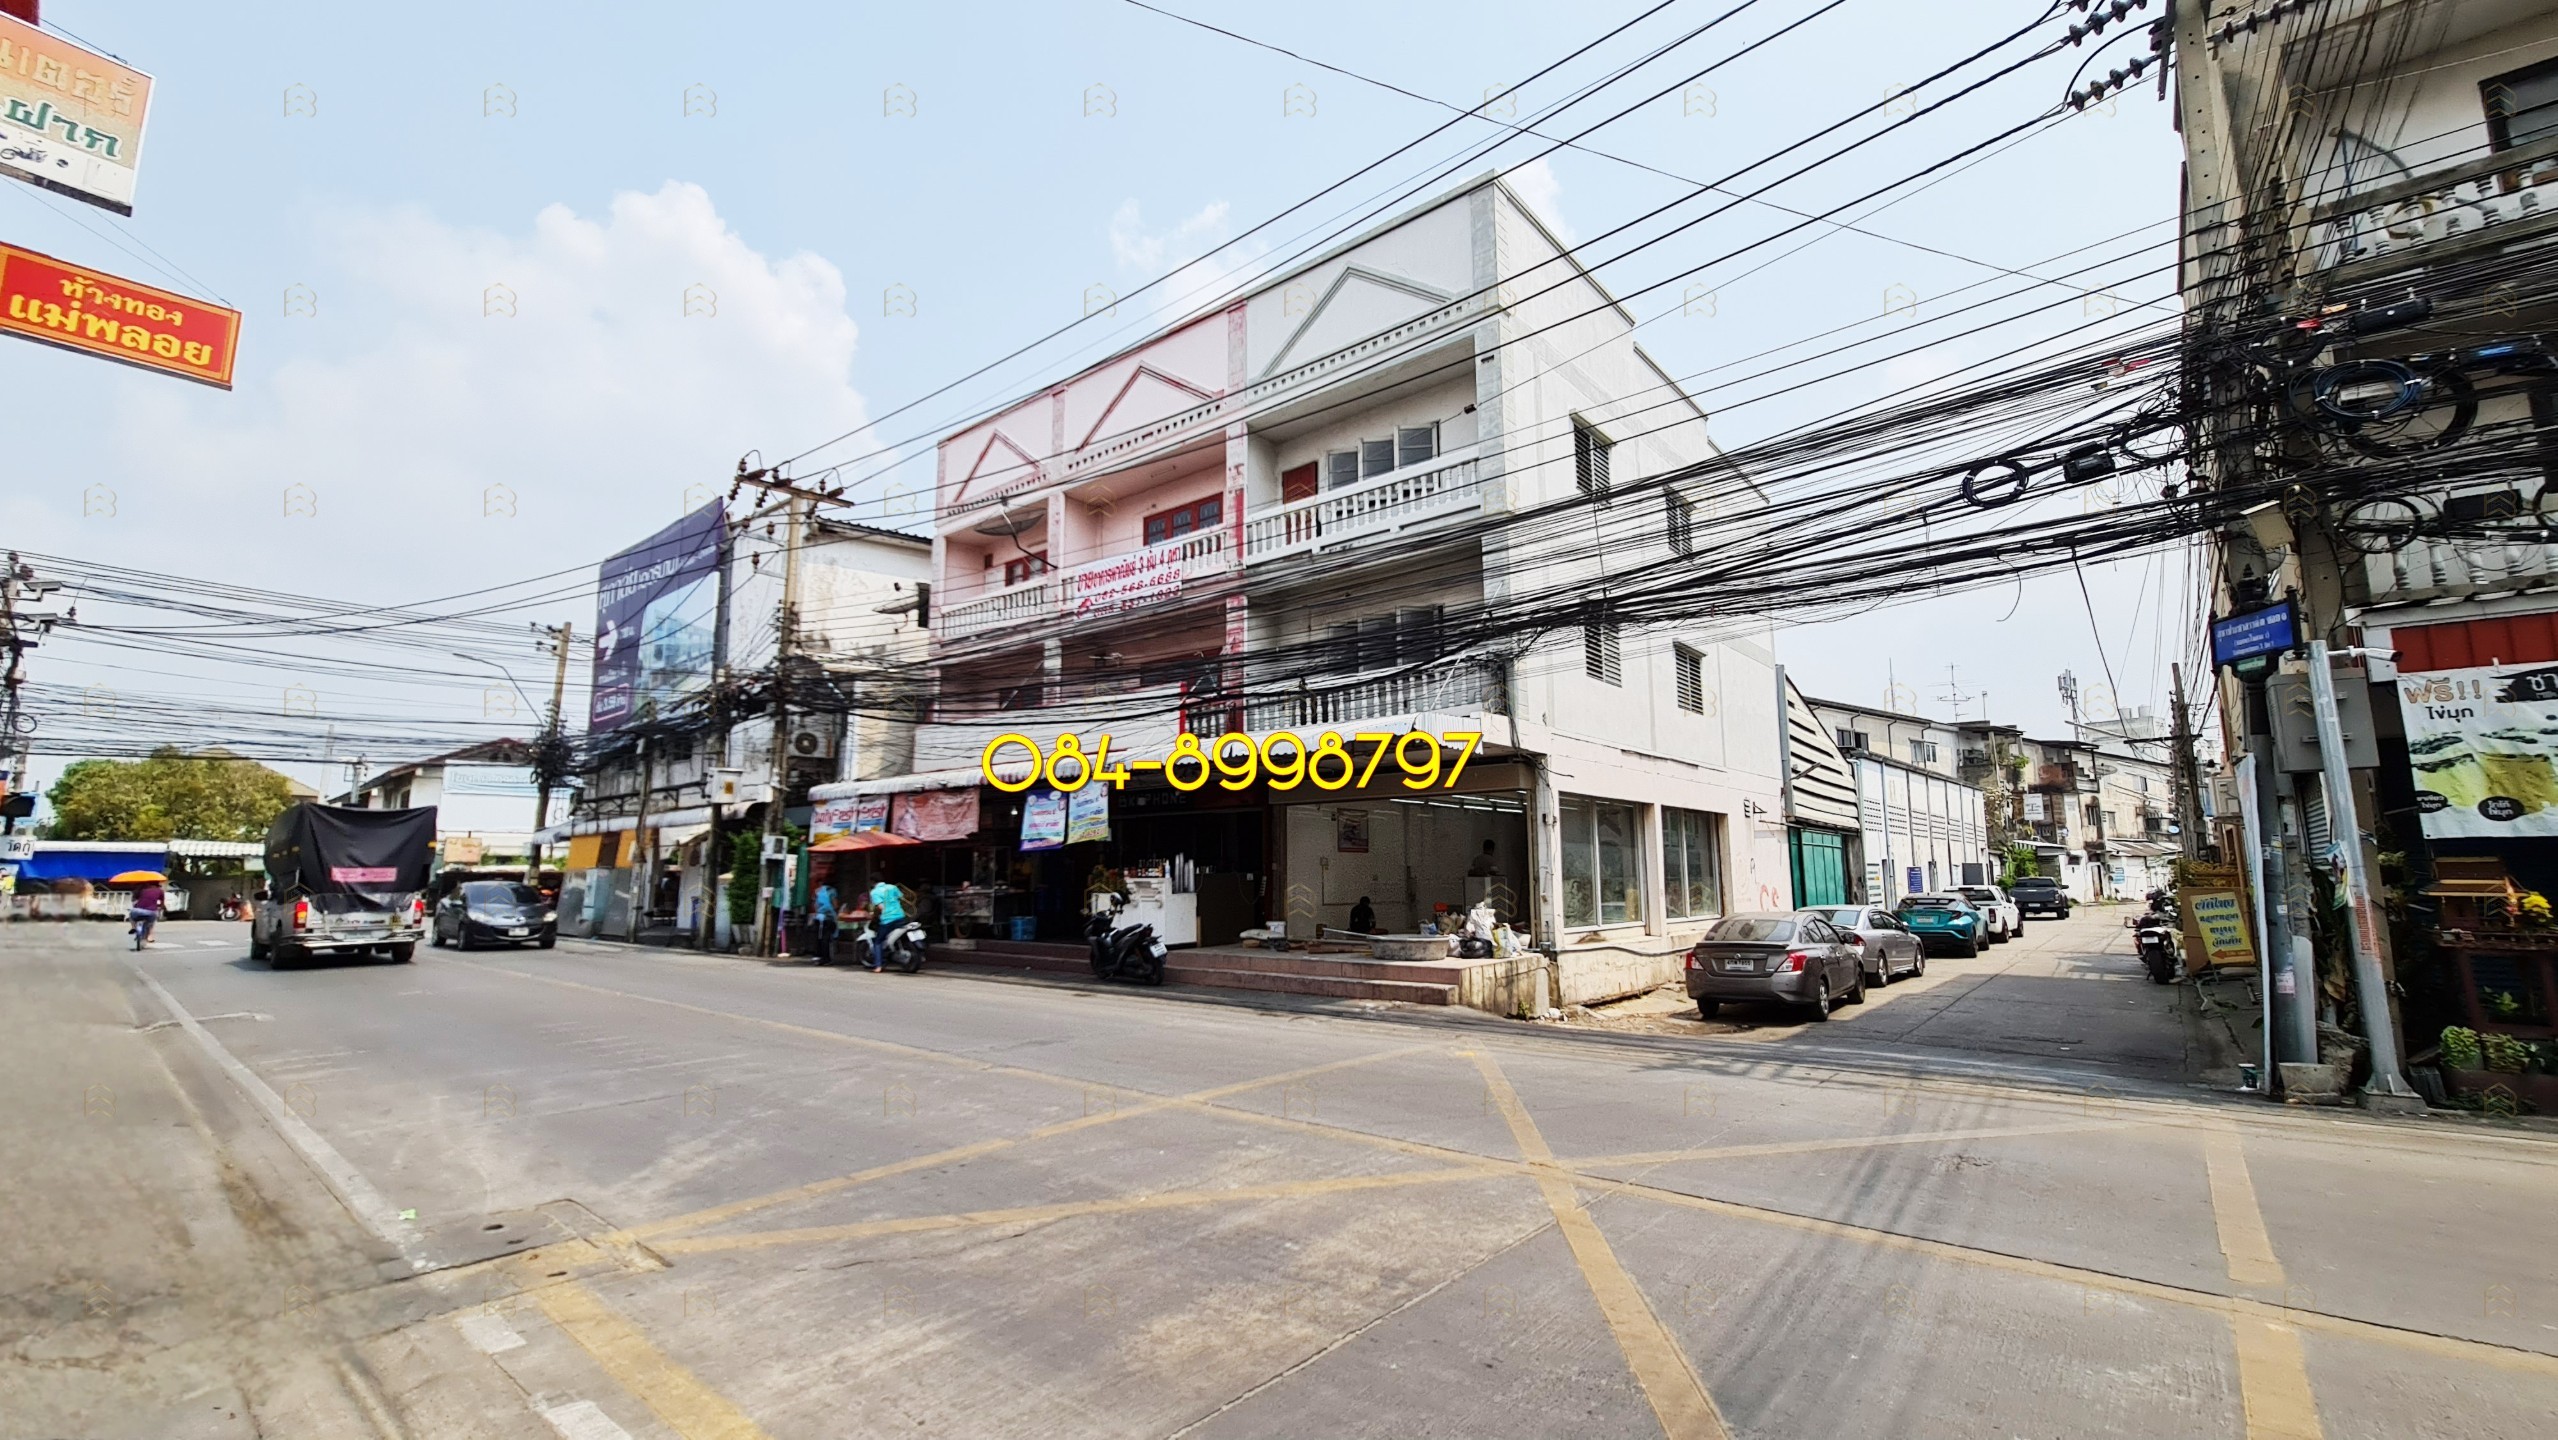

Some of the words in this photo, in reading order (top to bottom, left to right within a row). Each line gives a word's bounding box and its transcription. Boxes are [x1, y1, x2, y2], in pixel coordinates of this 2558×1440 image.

[59, 276, 184, 326] ห้างทอง
[9, 294, 213, 366] แม่พลอย
[2404, 677, 2482, 704] ฟรี!!
[2425, 705, 2474, 723] ไข่มุก
[7, 839, 31, 856] วัดกู้
